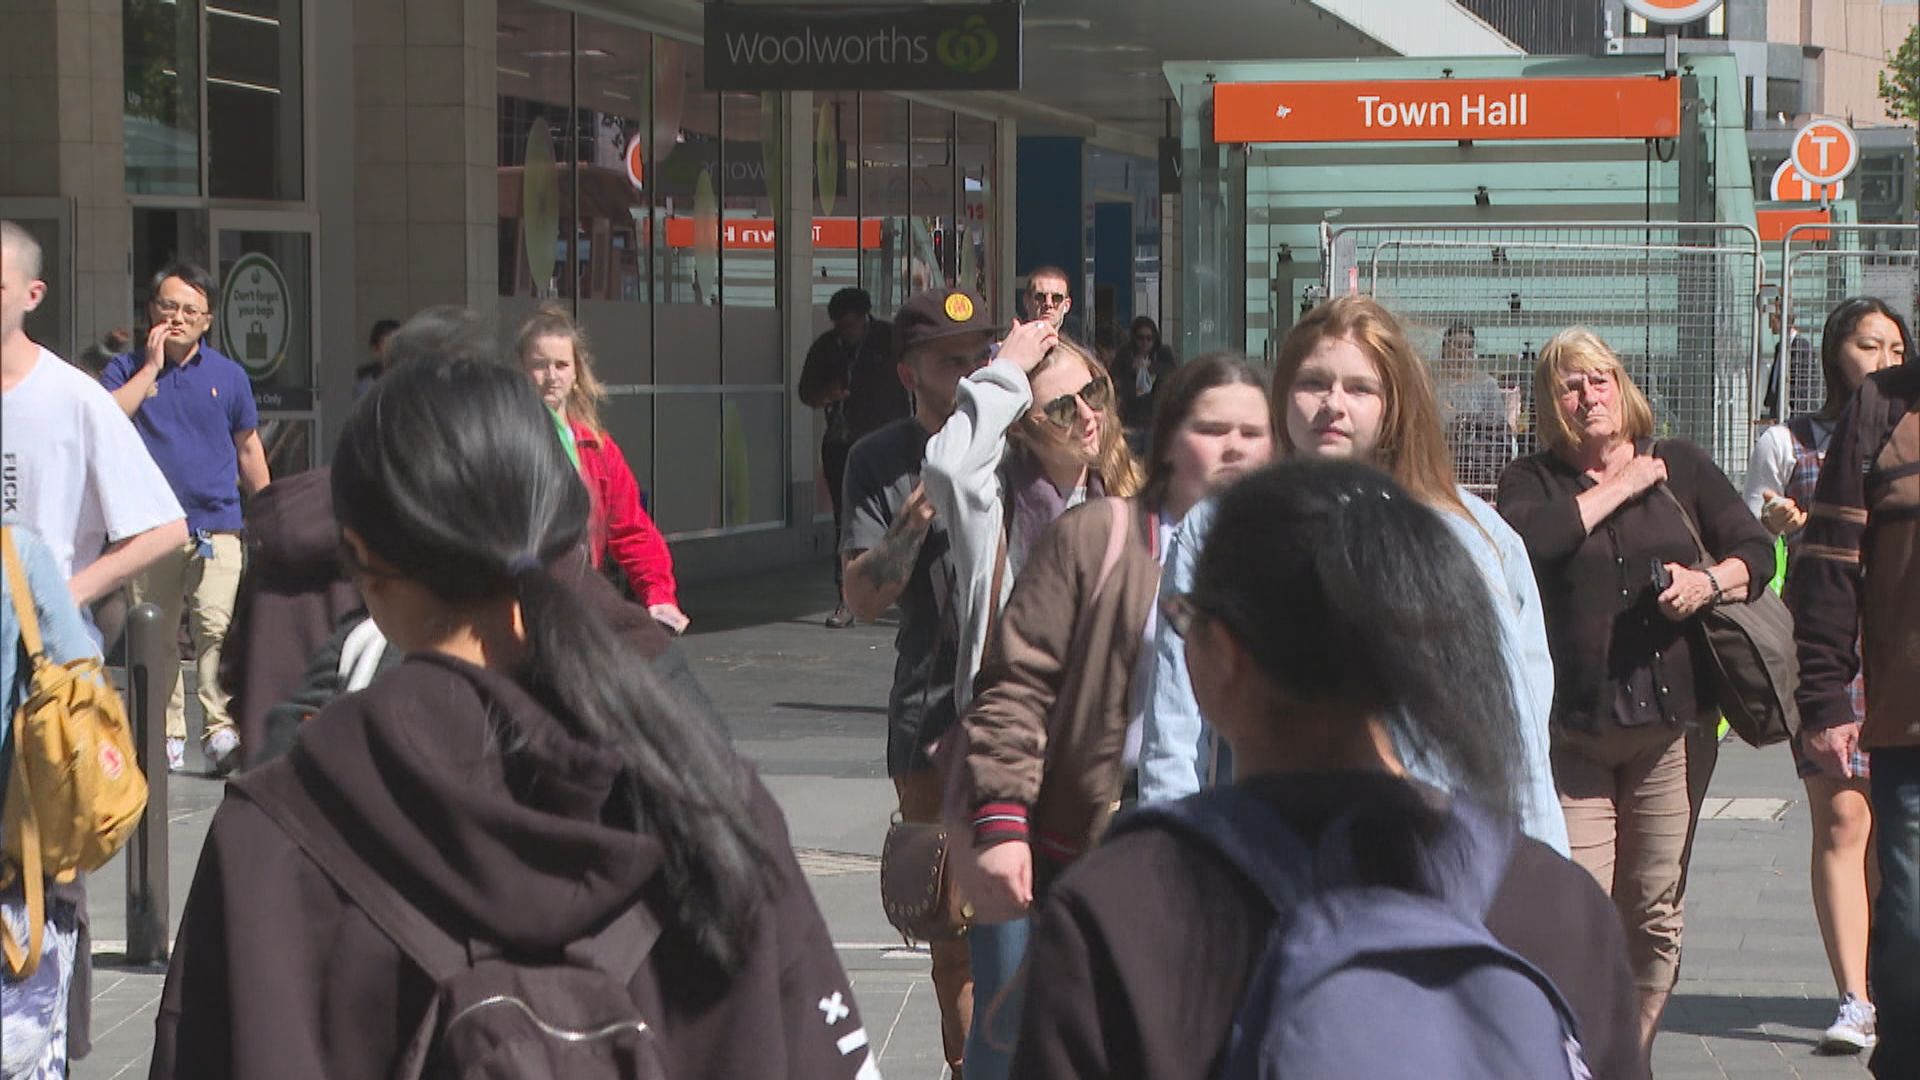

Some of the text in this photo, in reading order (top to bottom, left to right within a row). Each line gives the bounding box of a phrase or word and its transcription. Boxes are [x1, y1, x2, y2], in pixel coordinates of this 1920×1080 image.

[725, 26, 929, 64] Woolworths
[1357, 93, 1528, 127] Town Hall
[1811, 136, 1837, 171] T
[238, 304, 274, 319] your bags
[263, 393, 282, 406] Only
[3, 453, 17, 512] FUCK
